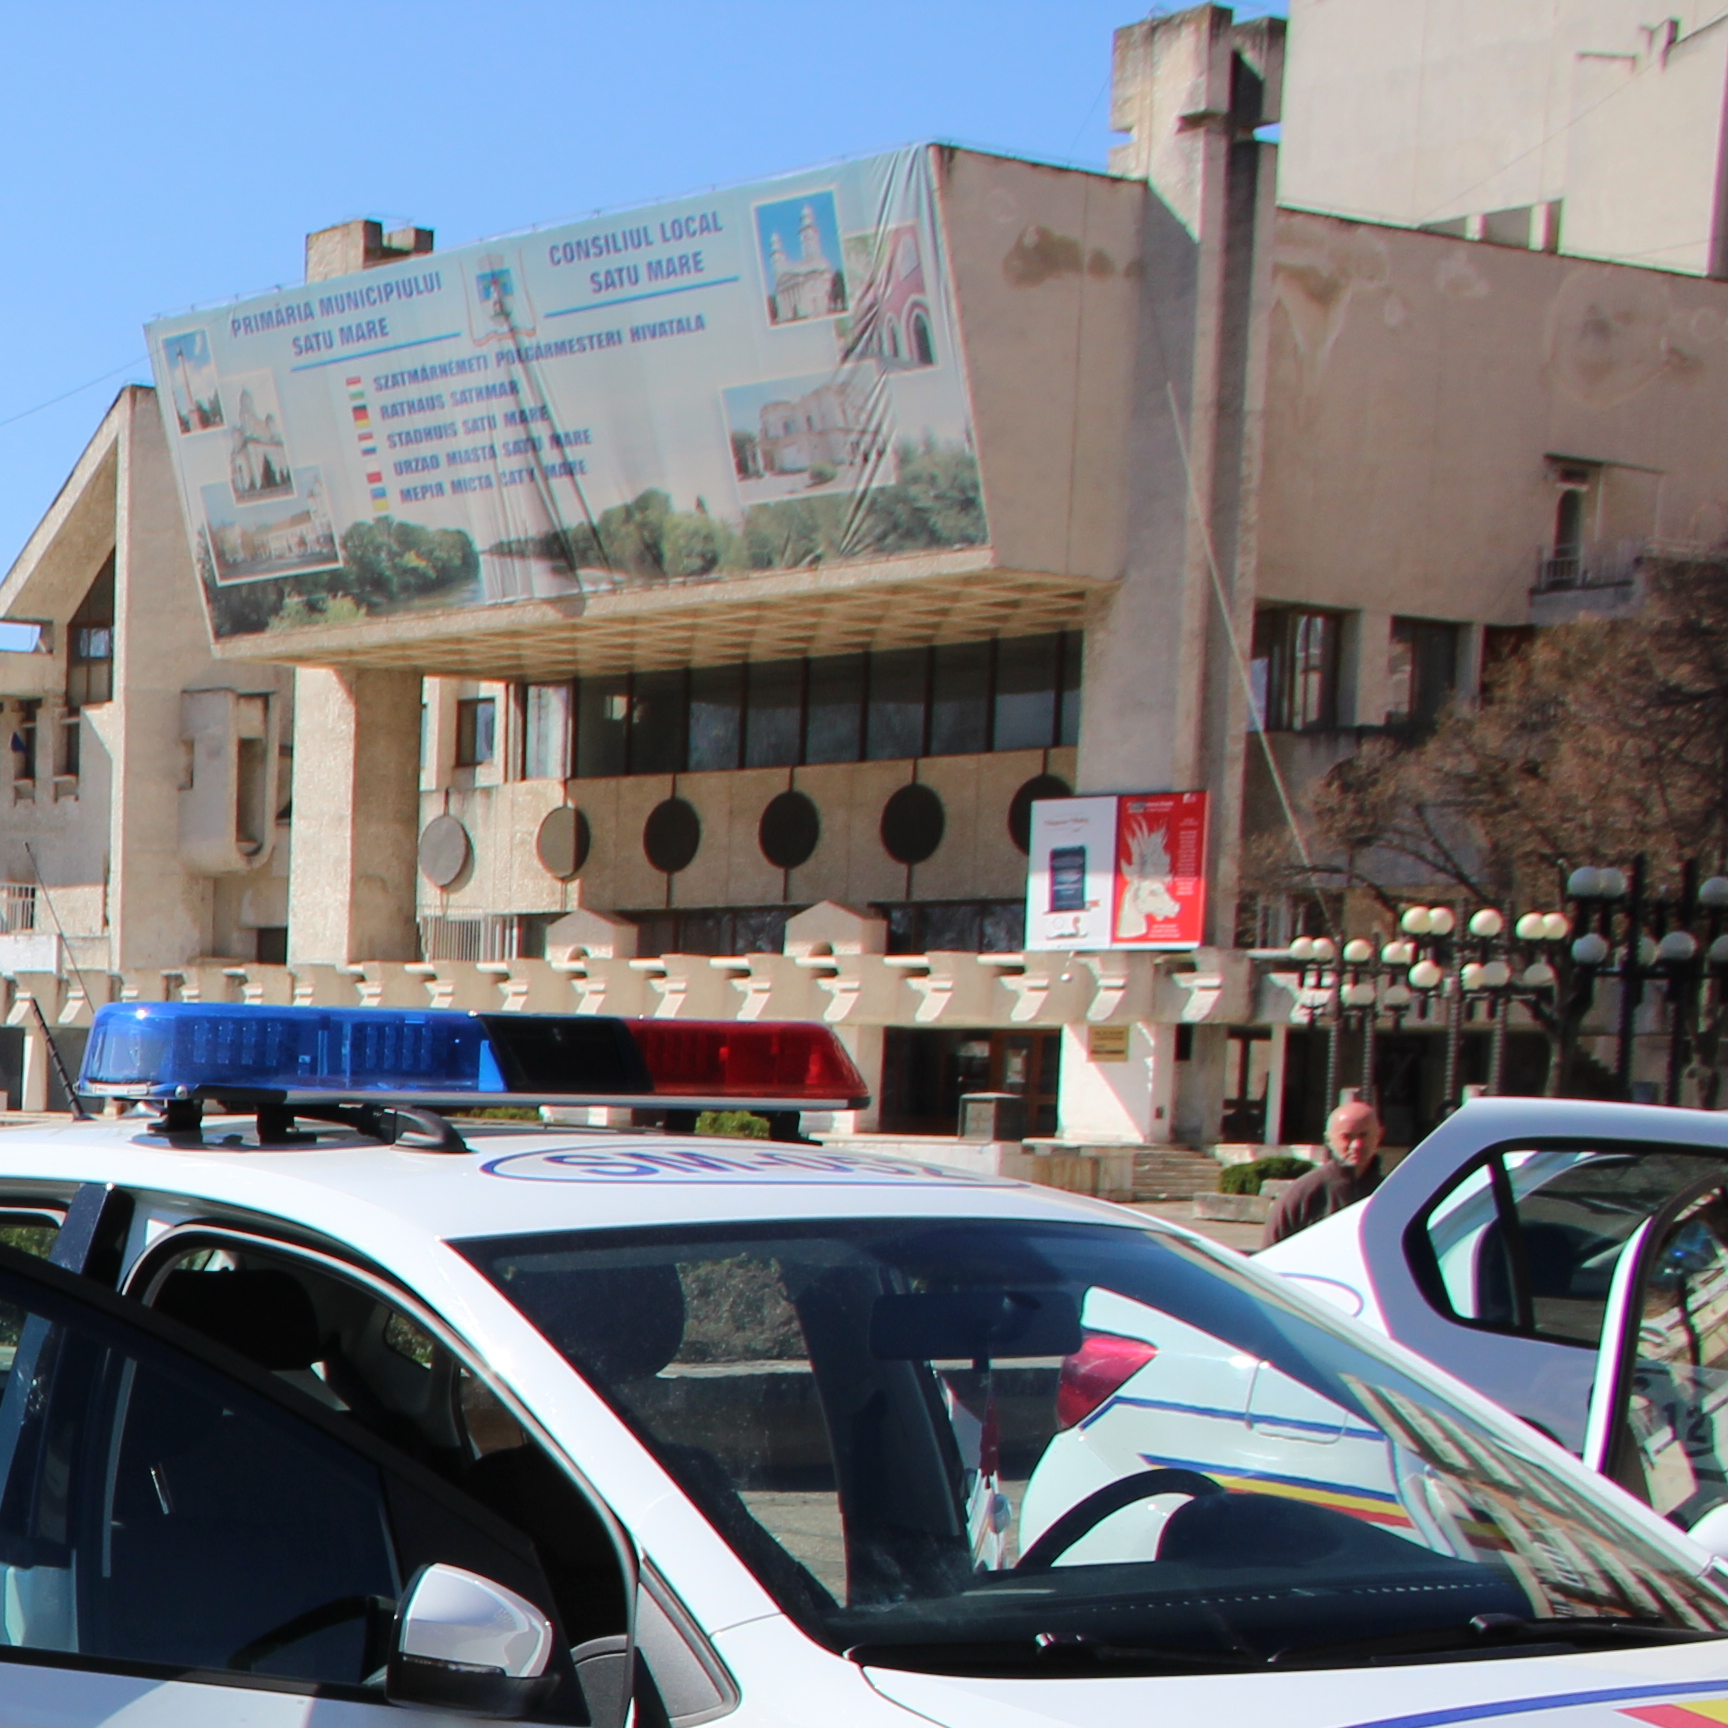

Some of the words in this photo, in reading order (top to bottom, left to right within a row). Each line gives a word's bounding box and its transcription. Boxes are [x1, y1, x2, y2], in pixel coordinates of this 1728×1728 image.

[548, 225, 654, 266] CONSILIUL
[660, 211, 723, 243] LOCAL
[590, 263, 639, 293] SATU
[647, 251, 704, 282] MARE
[319, 272, 442, 317] MUNICIPIULUI
[292, 329, 333, 356] SATU
[339, 317, 390, 345] MARE
[629, 314, 705, 343] HIVATALA
[462, 414, 497, 435] SATU
[504, 403, 550, 427] MARE
[549, 428, 592, 450] MARE
